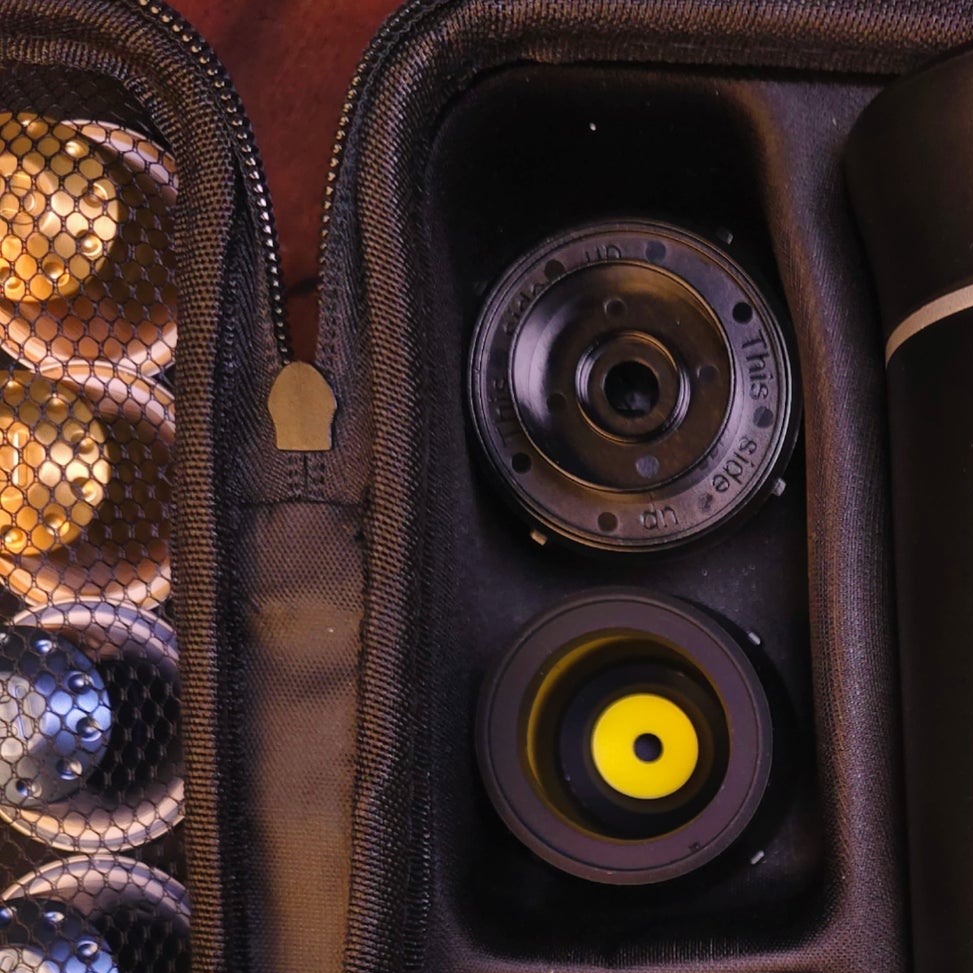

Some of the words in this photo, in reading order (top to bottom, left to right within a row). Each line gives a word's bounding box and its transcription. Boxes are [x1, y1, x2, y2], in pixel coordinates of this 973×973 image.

[742, 329, 774, 401] This
[712, 435, 758, 493] side
[640, 502, 680, 531] up
